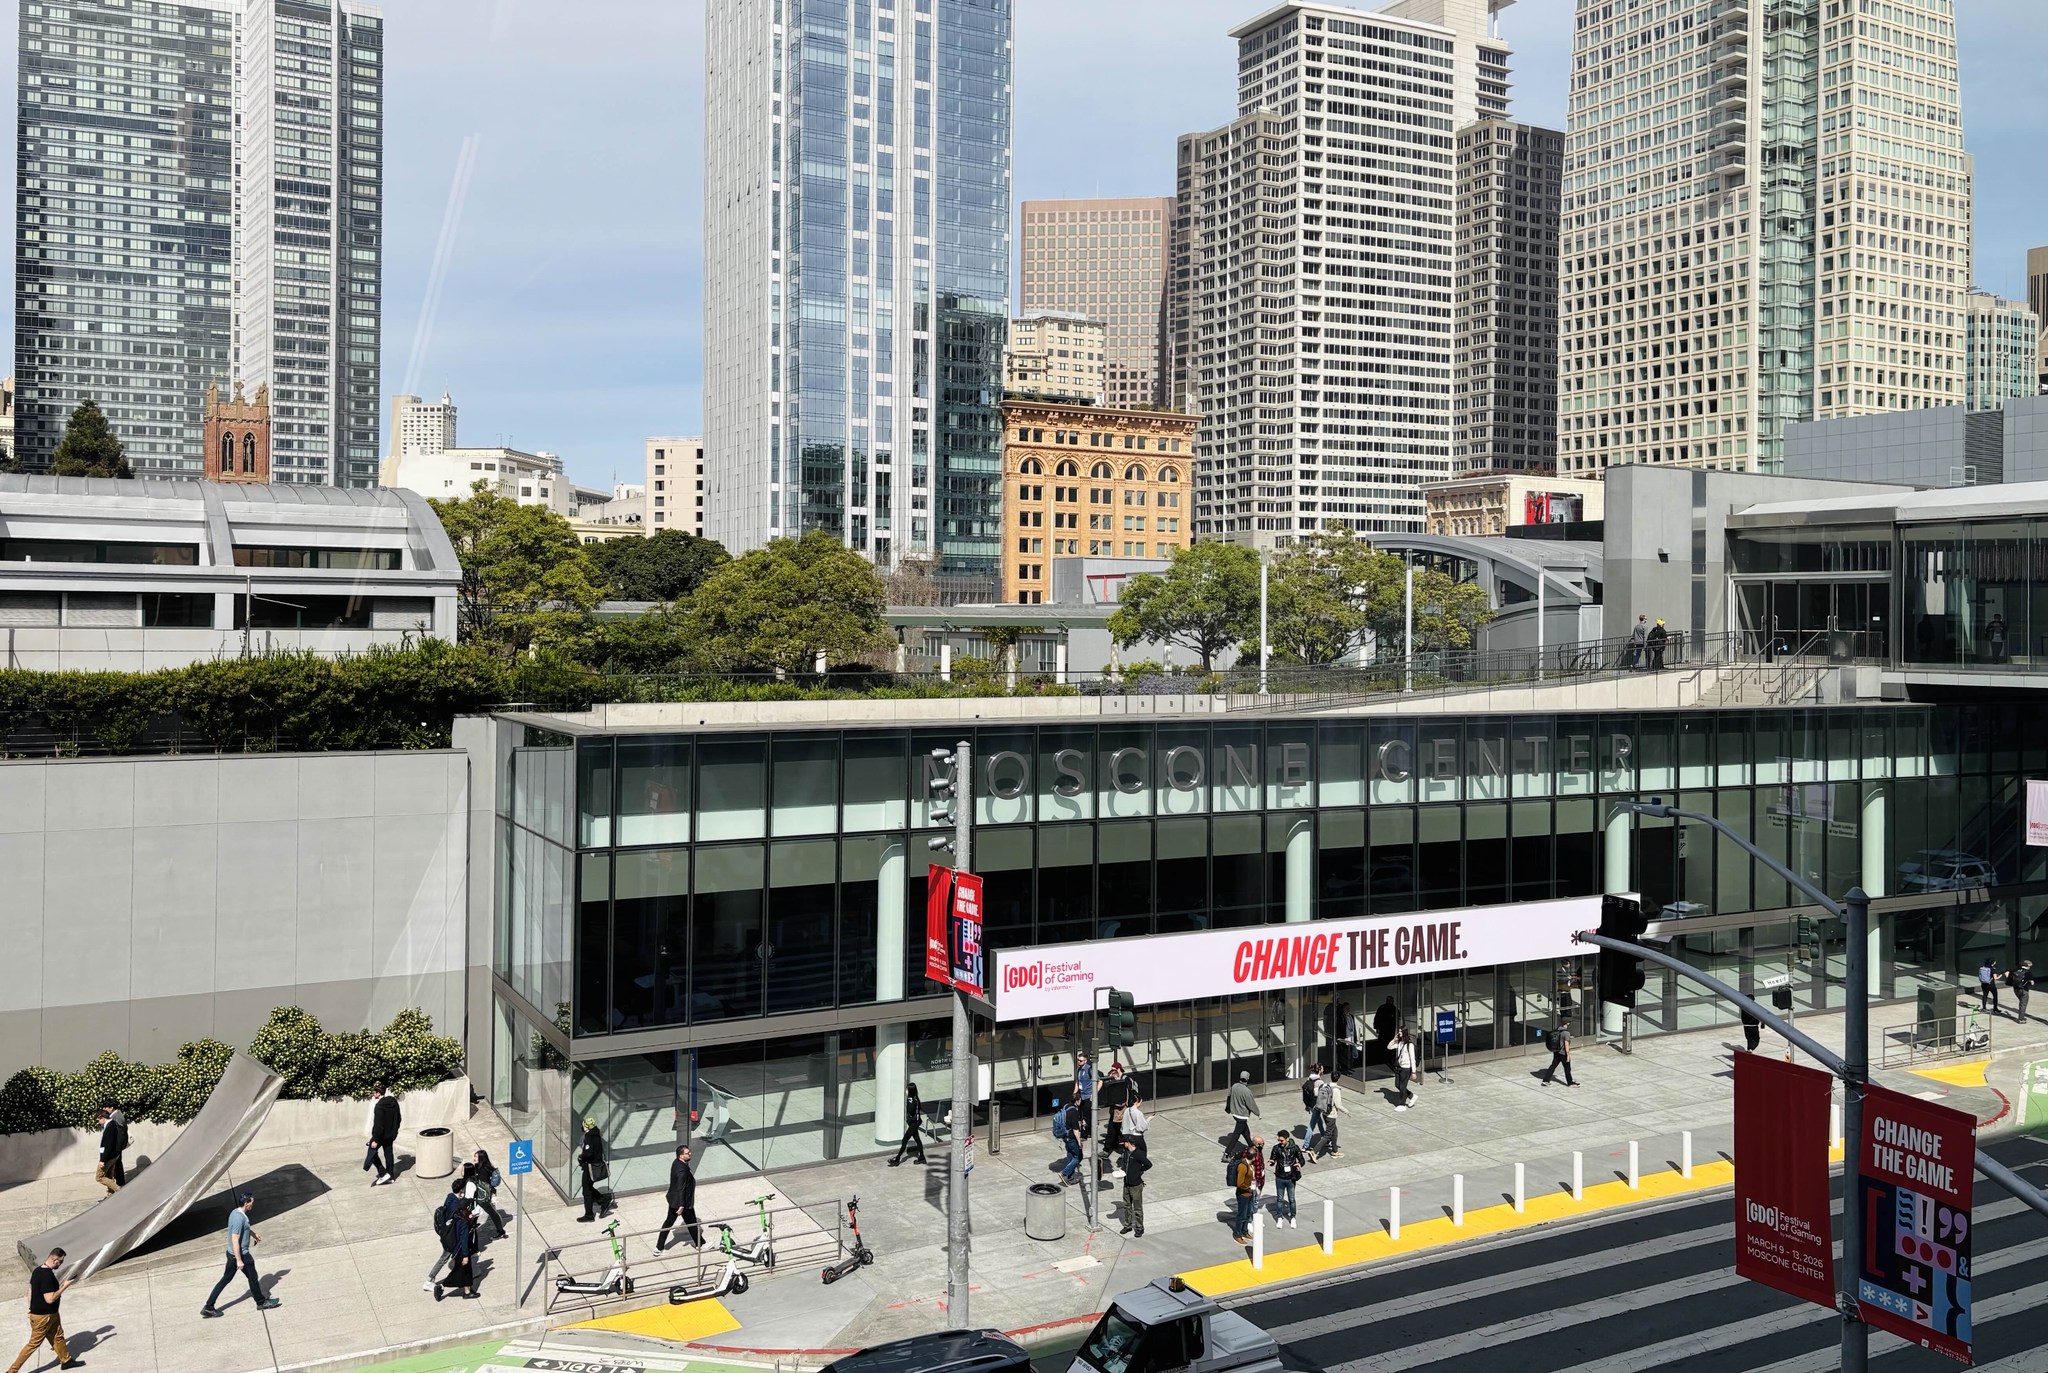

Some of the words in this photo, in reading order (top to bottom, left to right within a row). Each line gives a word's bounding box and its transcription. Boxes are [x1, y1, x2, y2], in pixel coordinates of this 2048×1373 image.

[1378, 733, 1633, 783] CENTER
[1045, 961, 1081, 974] Festival
[1233, 932, 1343, 984] CHANGE
[1347, 928, 1390, 971] THE
[1394, 921, 1468, 967] GAME.
[1045, 974, 1055, 985] of
[1057, 971, 1094, 983] Gaming
[1873, 1116, 1943, 1160] CHANGE
[1872, 1143, 1904, 1175] THE
[1905, 1154, 1958, 1195] GAME.
[1780, 1211, 1810, 1230] Festival
[1780, 1222, 1789, 1232] of
[1790, 1225, 1822, 1246] Gaming
[1747, 1234, 1777, 1252] MARCH
[1778, 1245, 1785, 1254] 9
[1792, 1250, 1802, 1261] 13,
[1803, 1254, 1824, 1268] 2026
[1747, 1246, 1790, 1269] MOSCONE
[1791, 1262, 1824, 1281] CENTER
